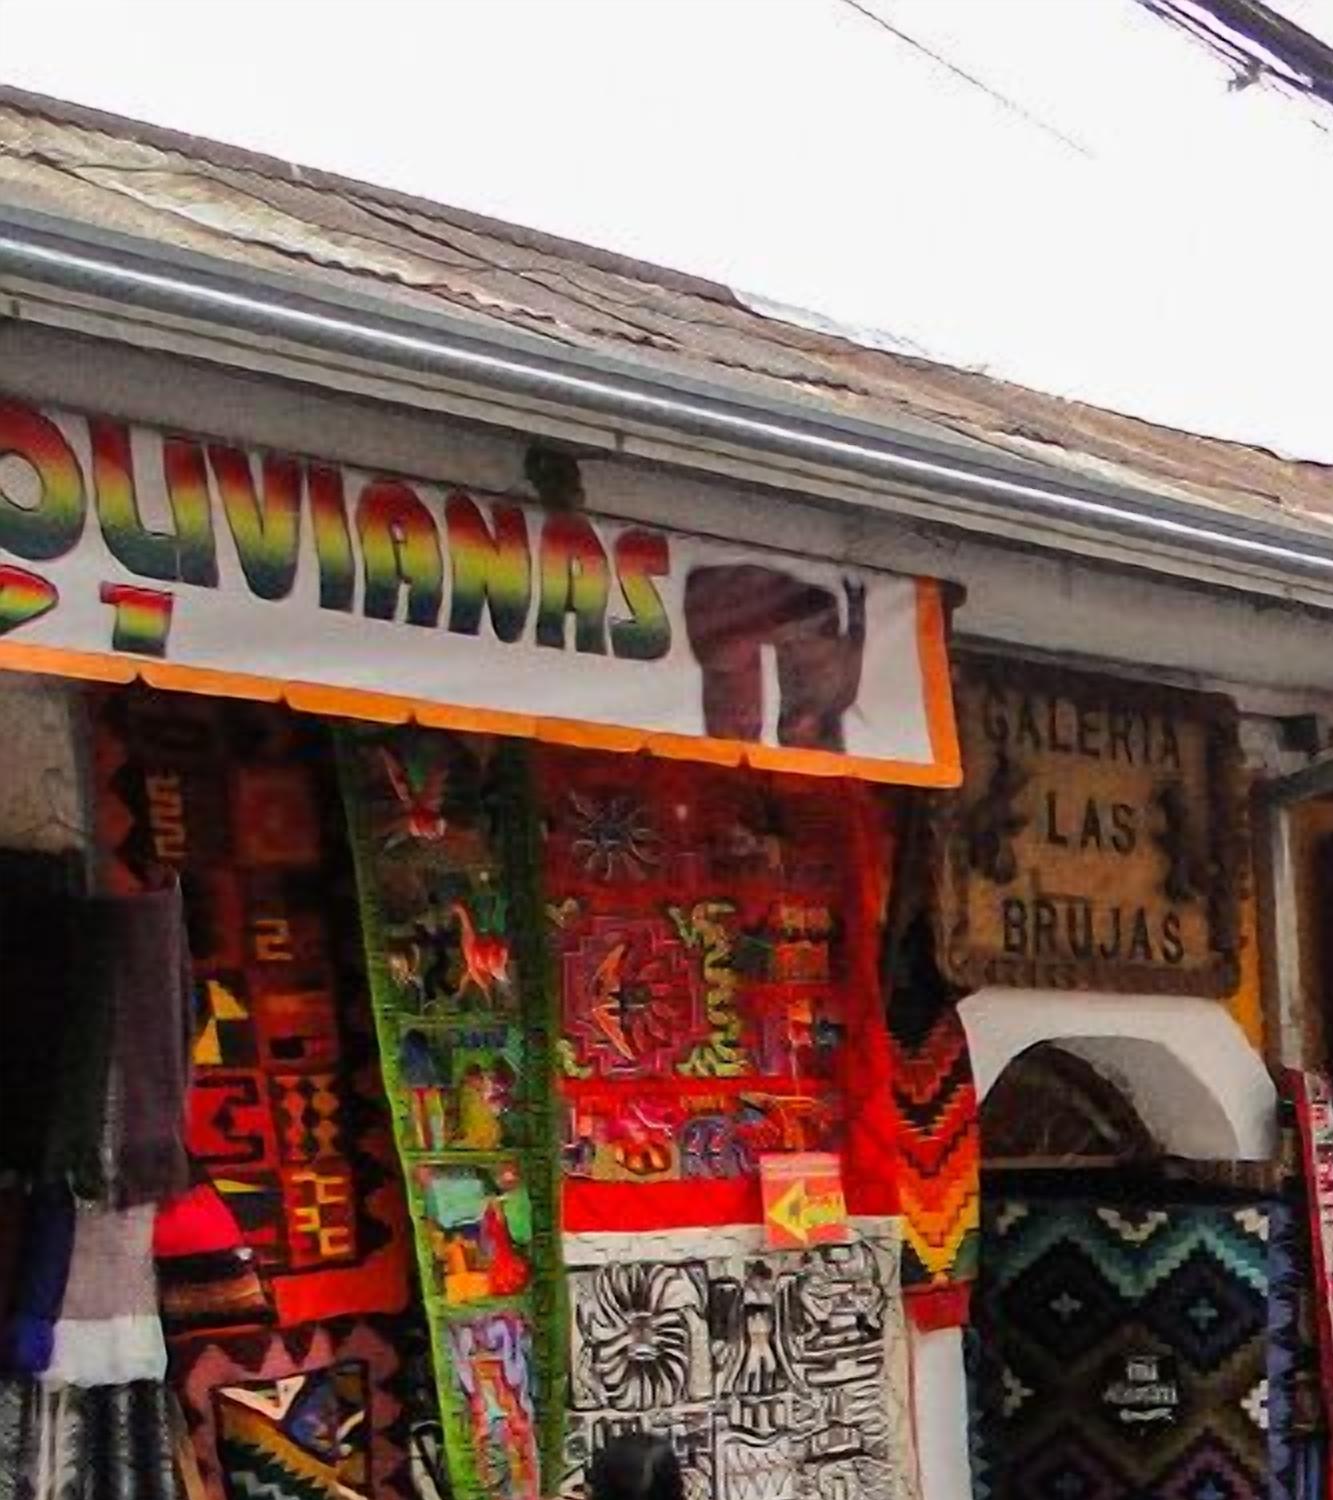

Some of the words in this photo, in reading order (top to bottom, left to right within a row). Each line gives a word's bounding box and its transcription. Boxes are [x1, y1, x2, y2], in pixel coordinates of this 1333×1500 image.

[983, 688, 1181, 768] GALERIA
[1046, 790, 1137, 857] LAS
[1002, 899, 1185, 965] BRUJAS
